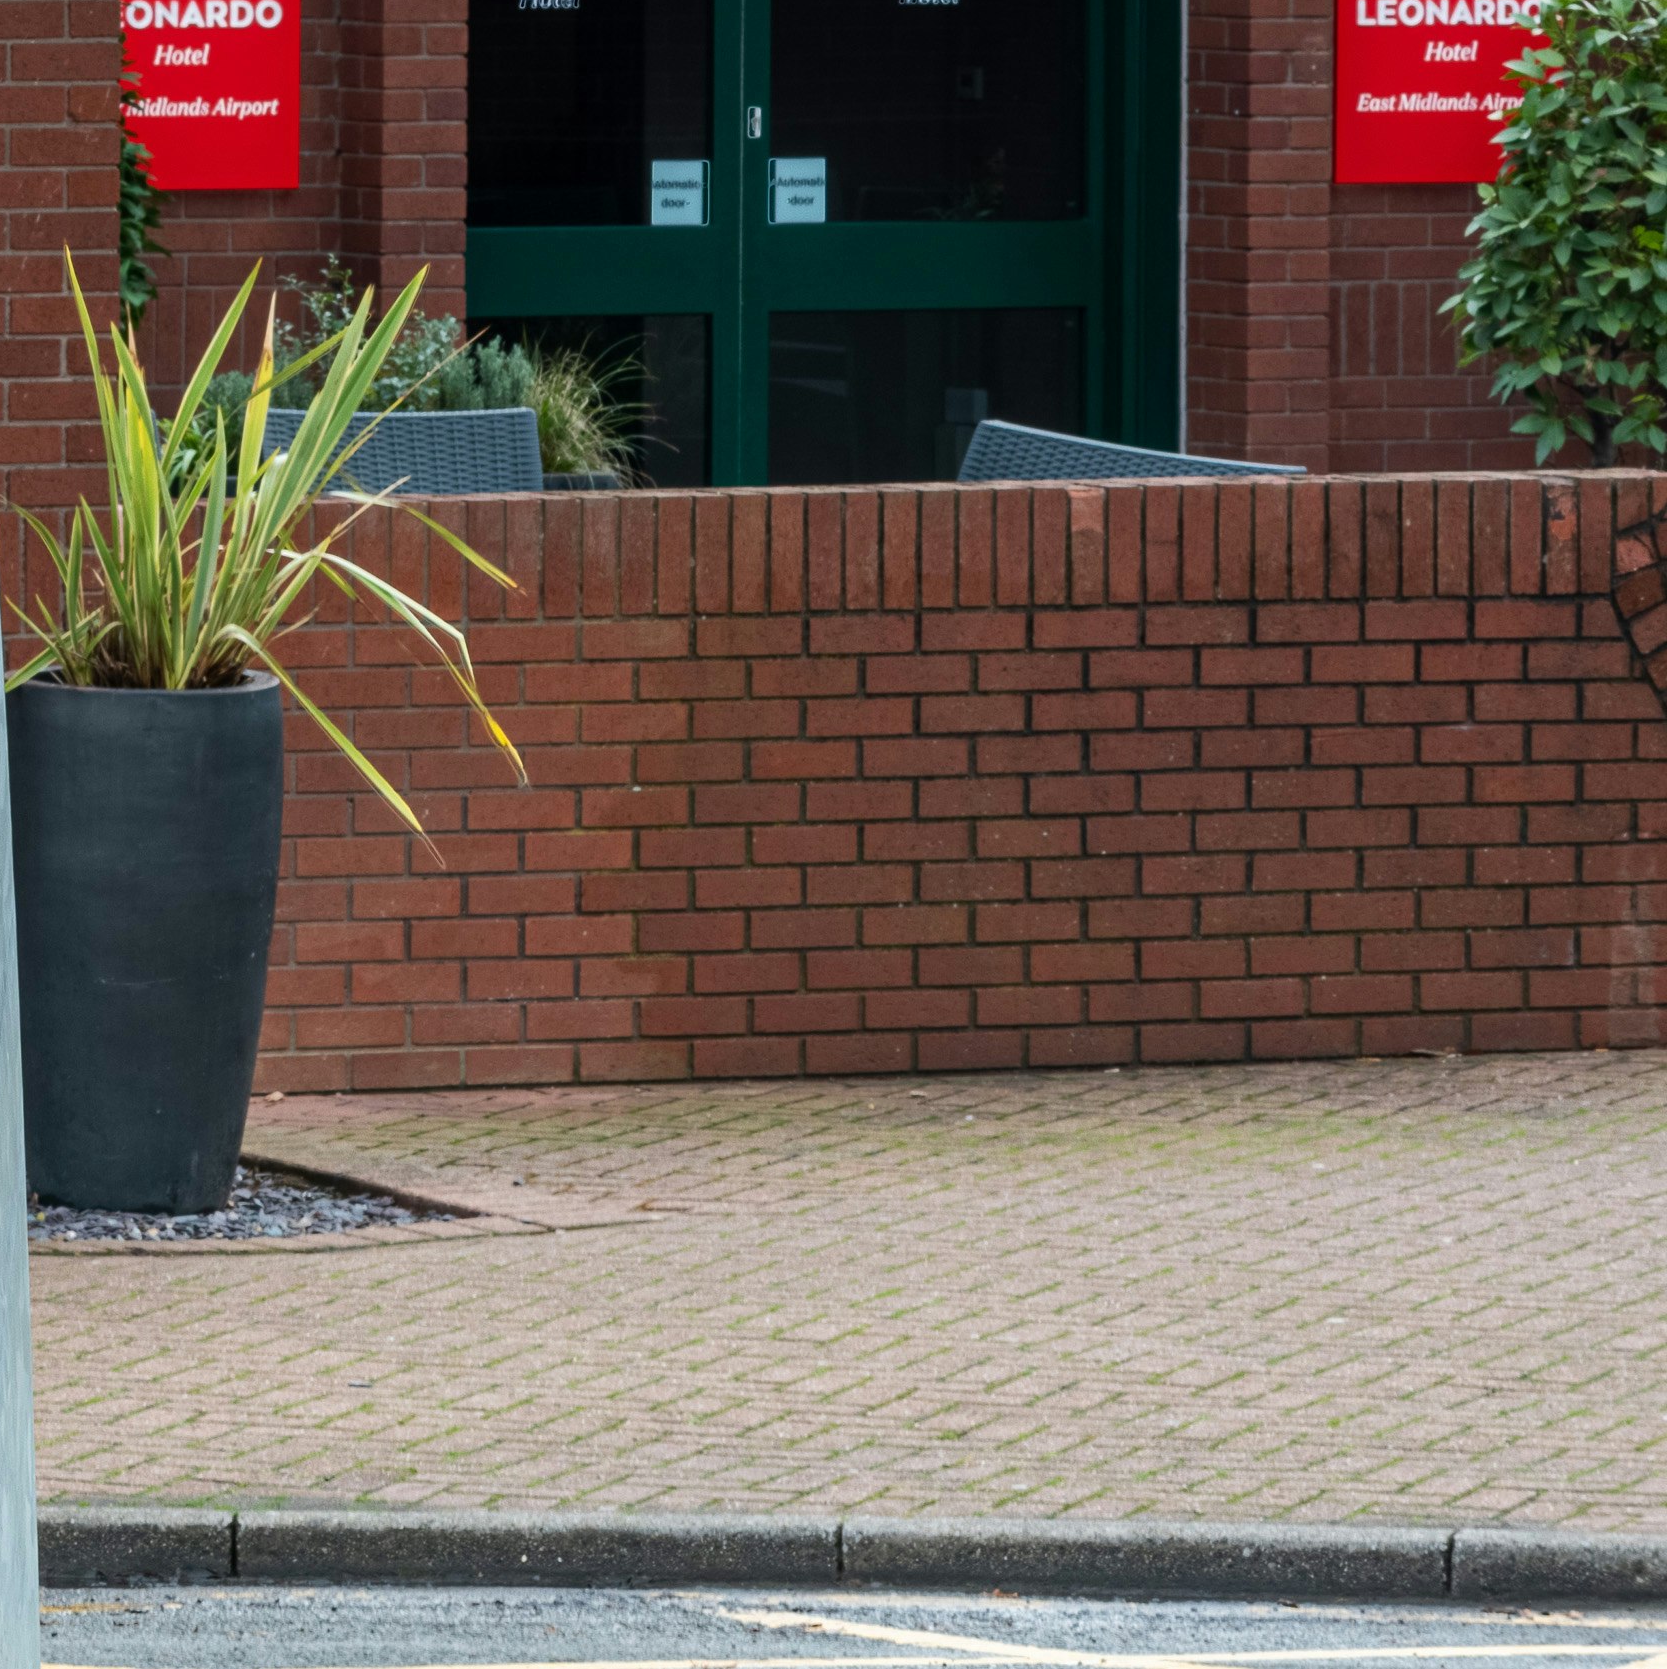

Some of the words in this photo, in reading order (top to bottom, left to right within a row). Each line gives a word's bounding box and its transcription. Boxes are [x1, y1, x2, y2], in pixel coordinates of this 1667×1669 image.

[153, 43, 210, 66] Hotel
[1424, 40, 1478, 62] Hotel
[212, 97, 279, 120] Airport
[1356, 92, 1395, 112] East
[1398, 92, 1478, 112] Midlands
